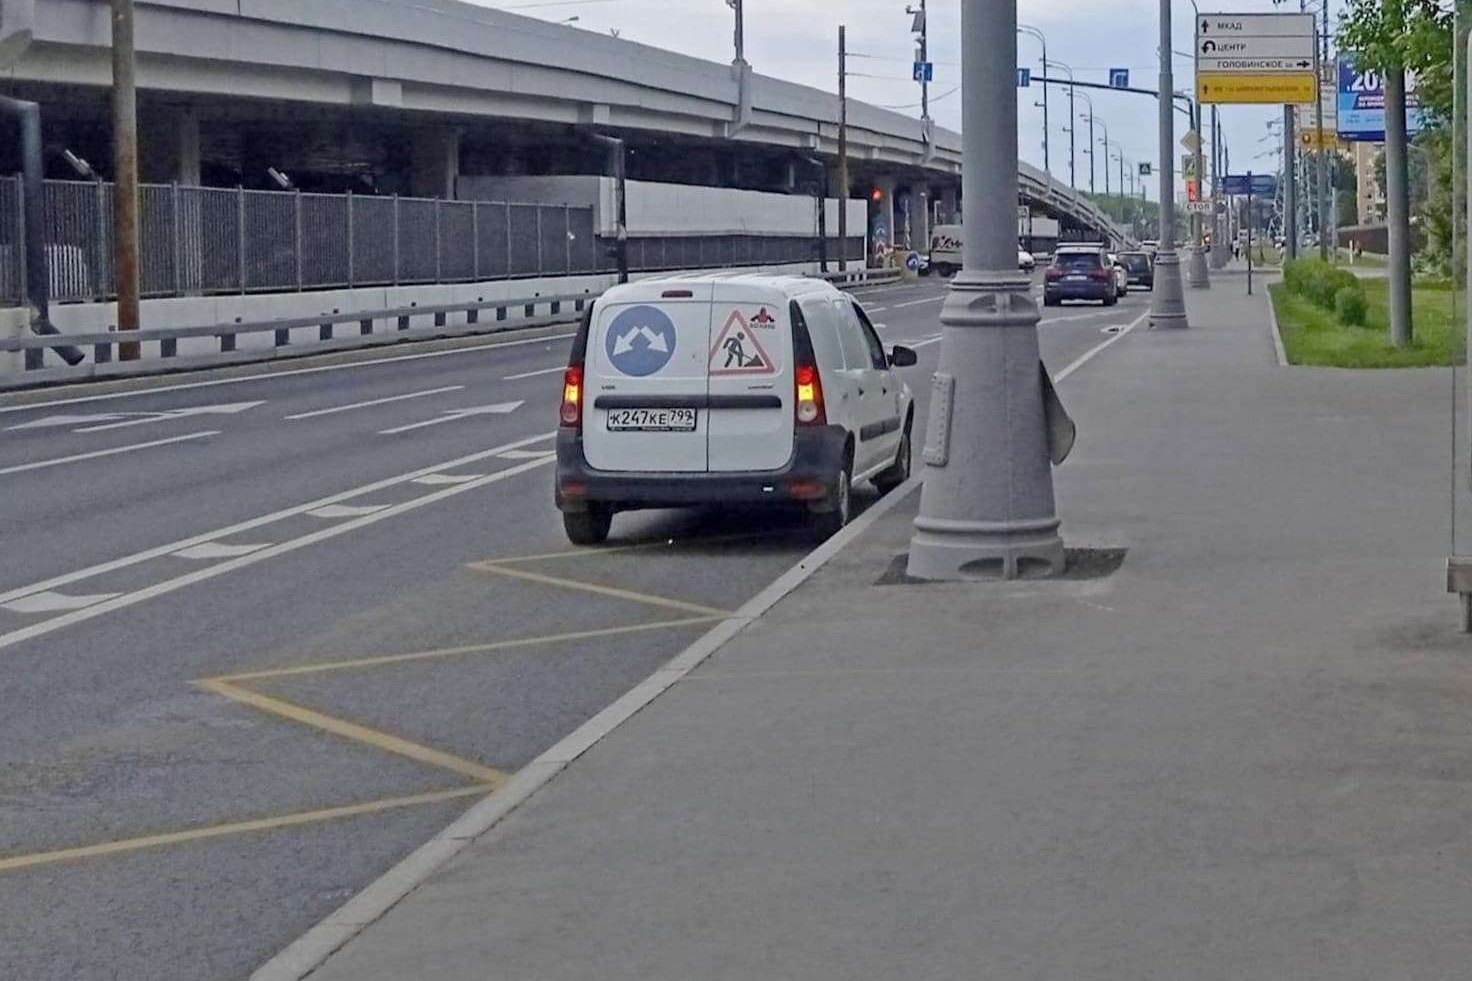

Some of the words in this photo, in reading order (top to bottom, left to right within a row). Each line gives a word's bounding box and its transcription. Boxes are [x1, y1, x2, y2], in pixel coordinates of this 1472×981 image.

[1216, 22, 1243, 30] МКАД
[1217, 43, 1247, 52] ЦЕНТР
[670, 409, 692, 421] 799
